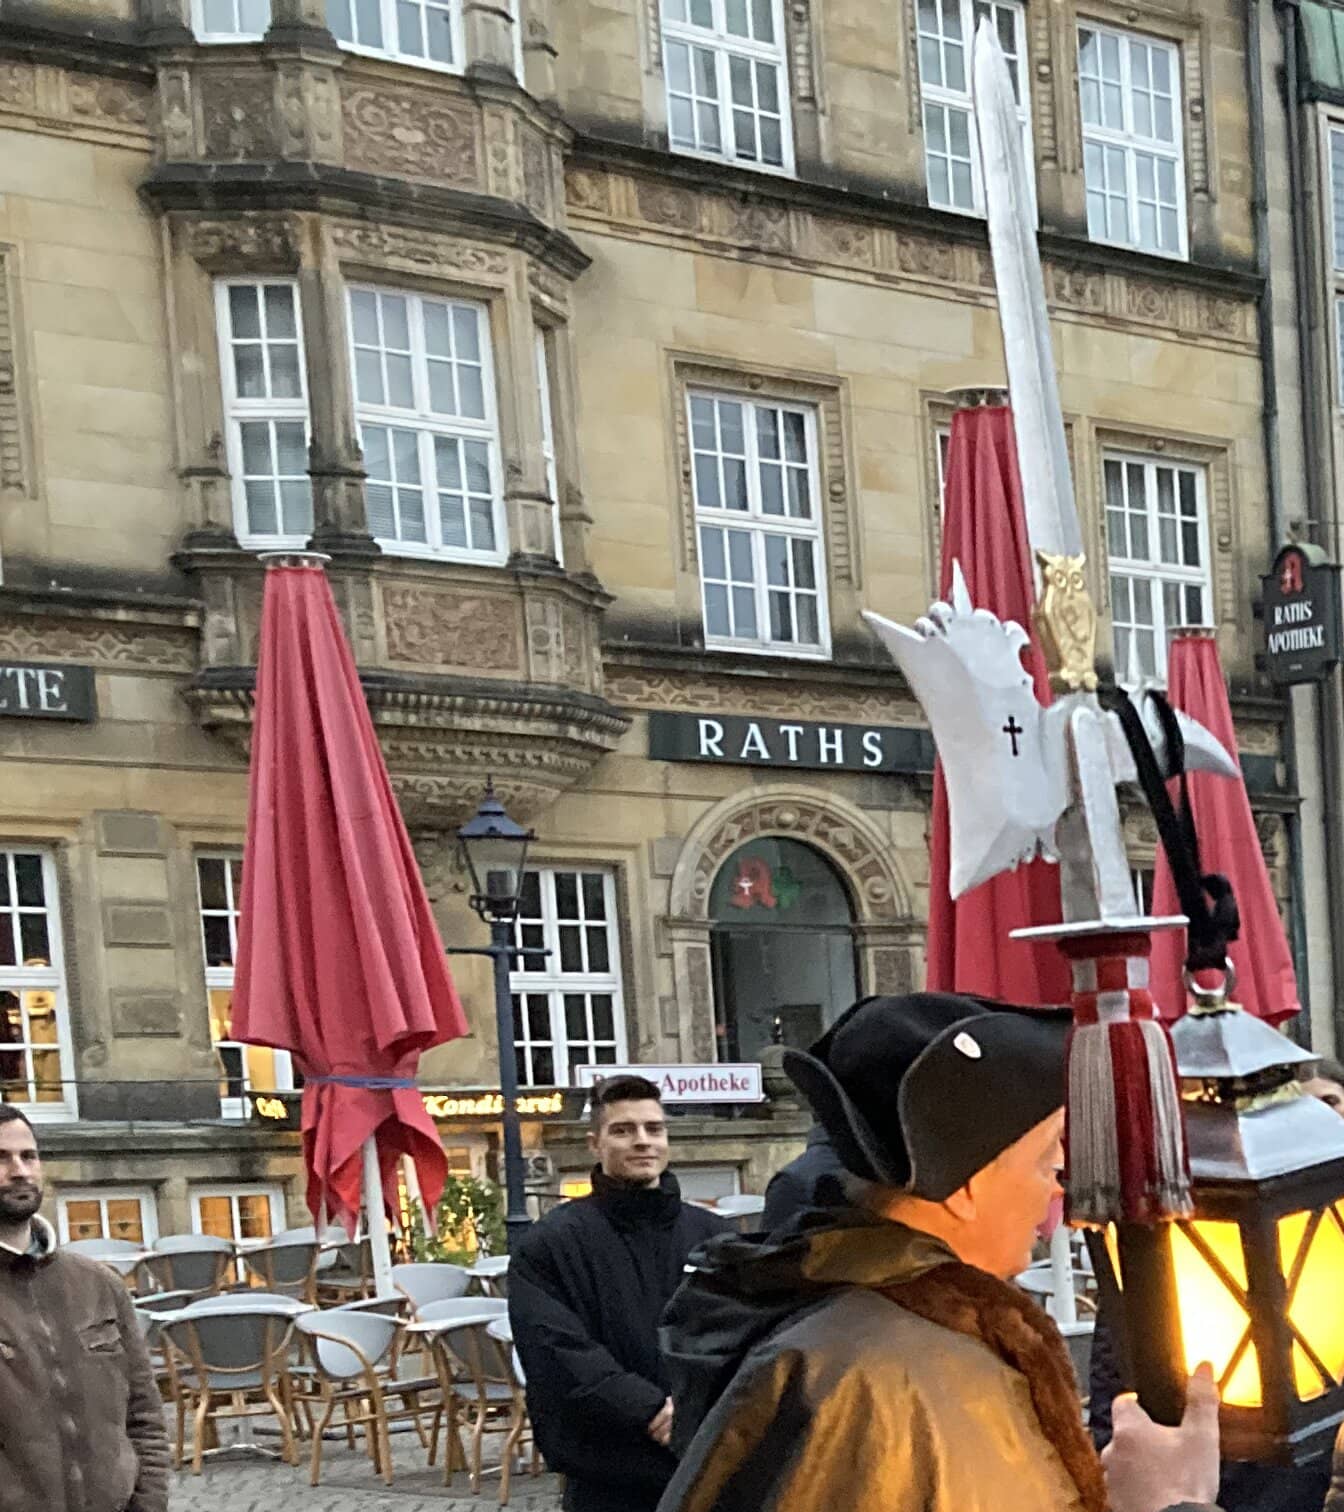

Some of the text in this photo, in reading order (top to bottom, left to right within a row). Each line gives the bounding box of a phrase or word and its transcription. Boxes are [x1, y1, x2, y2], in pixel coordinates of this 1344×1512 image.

[1274, 600, 1313, 626] RATHS
[1268, 624, 1325, 655] APOTHEKE
[698, 719, 884, 767] RATHS
[423, 1093, 562, 1117] Kondiorei
